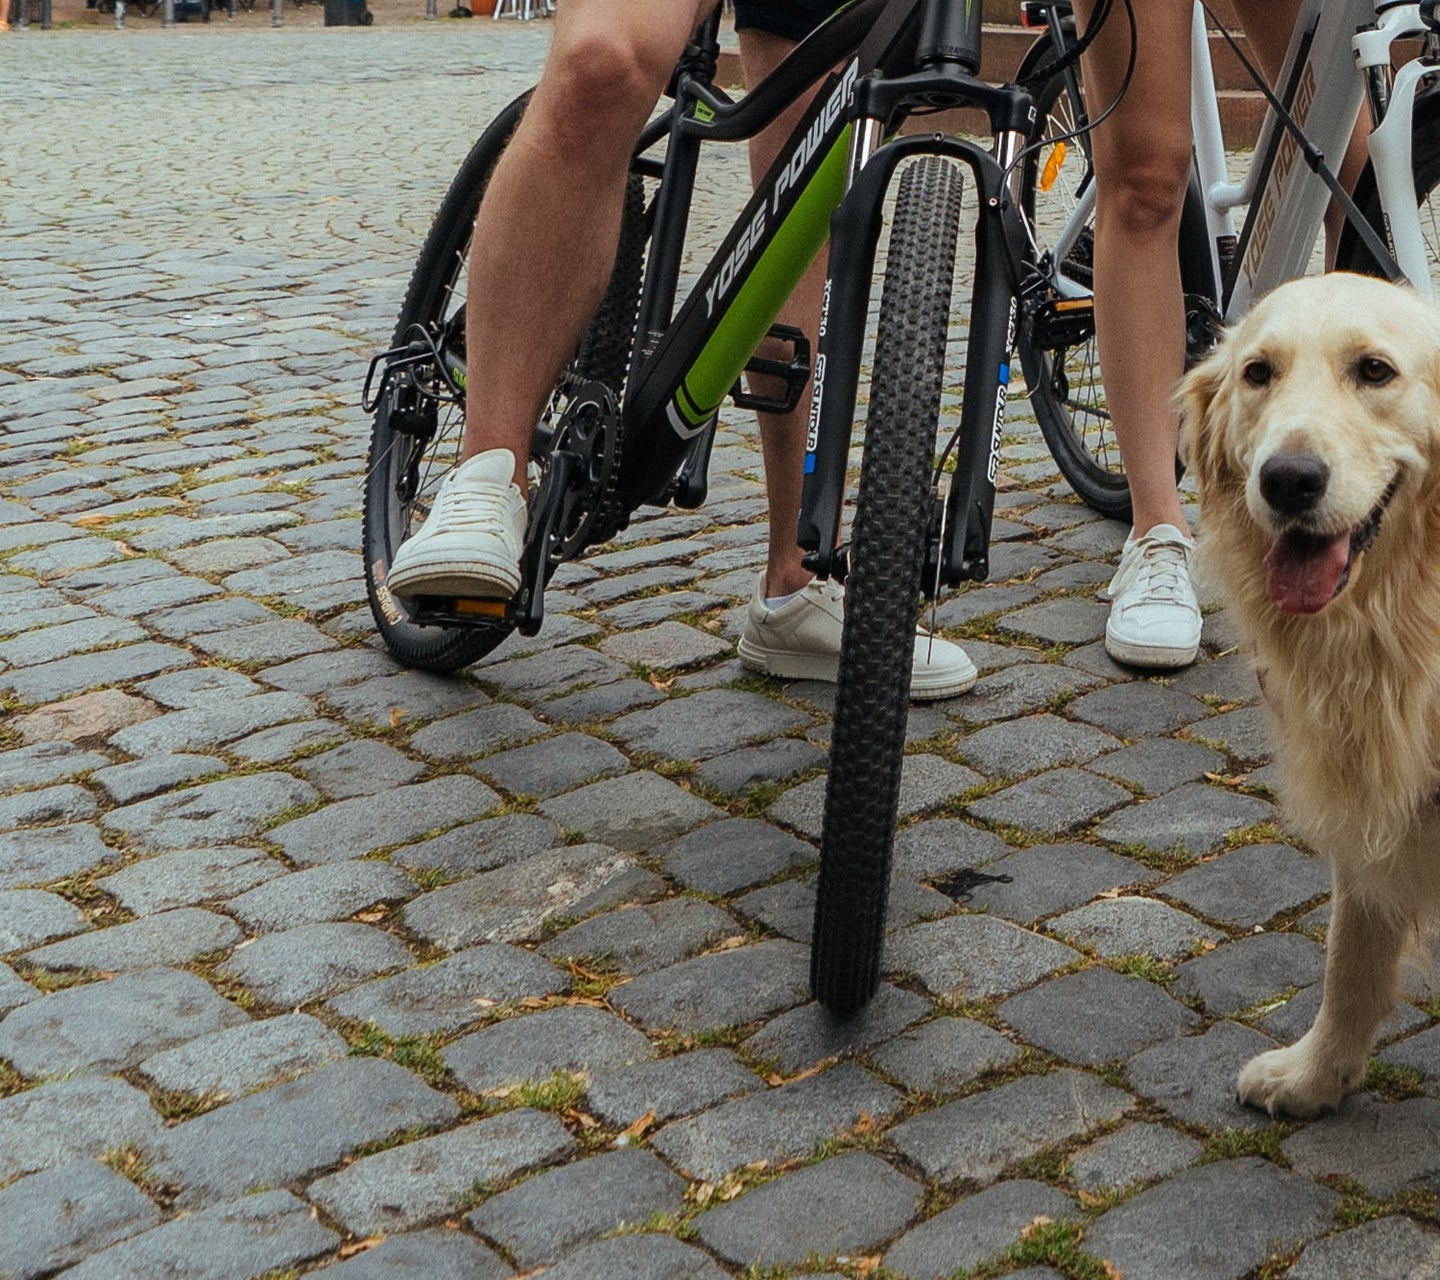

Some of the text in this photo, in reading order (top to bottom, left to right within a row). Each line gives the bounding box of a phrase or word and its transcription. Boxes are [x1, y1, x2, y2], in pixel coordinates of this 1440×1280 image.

[705, 56, 859, 320] YOSE POWER
[1243, 187, 1276, 290] YOSE
